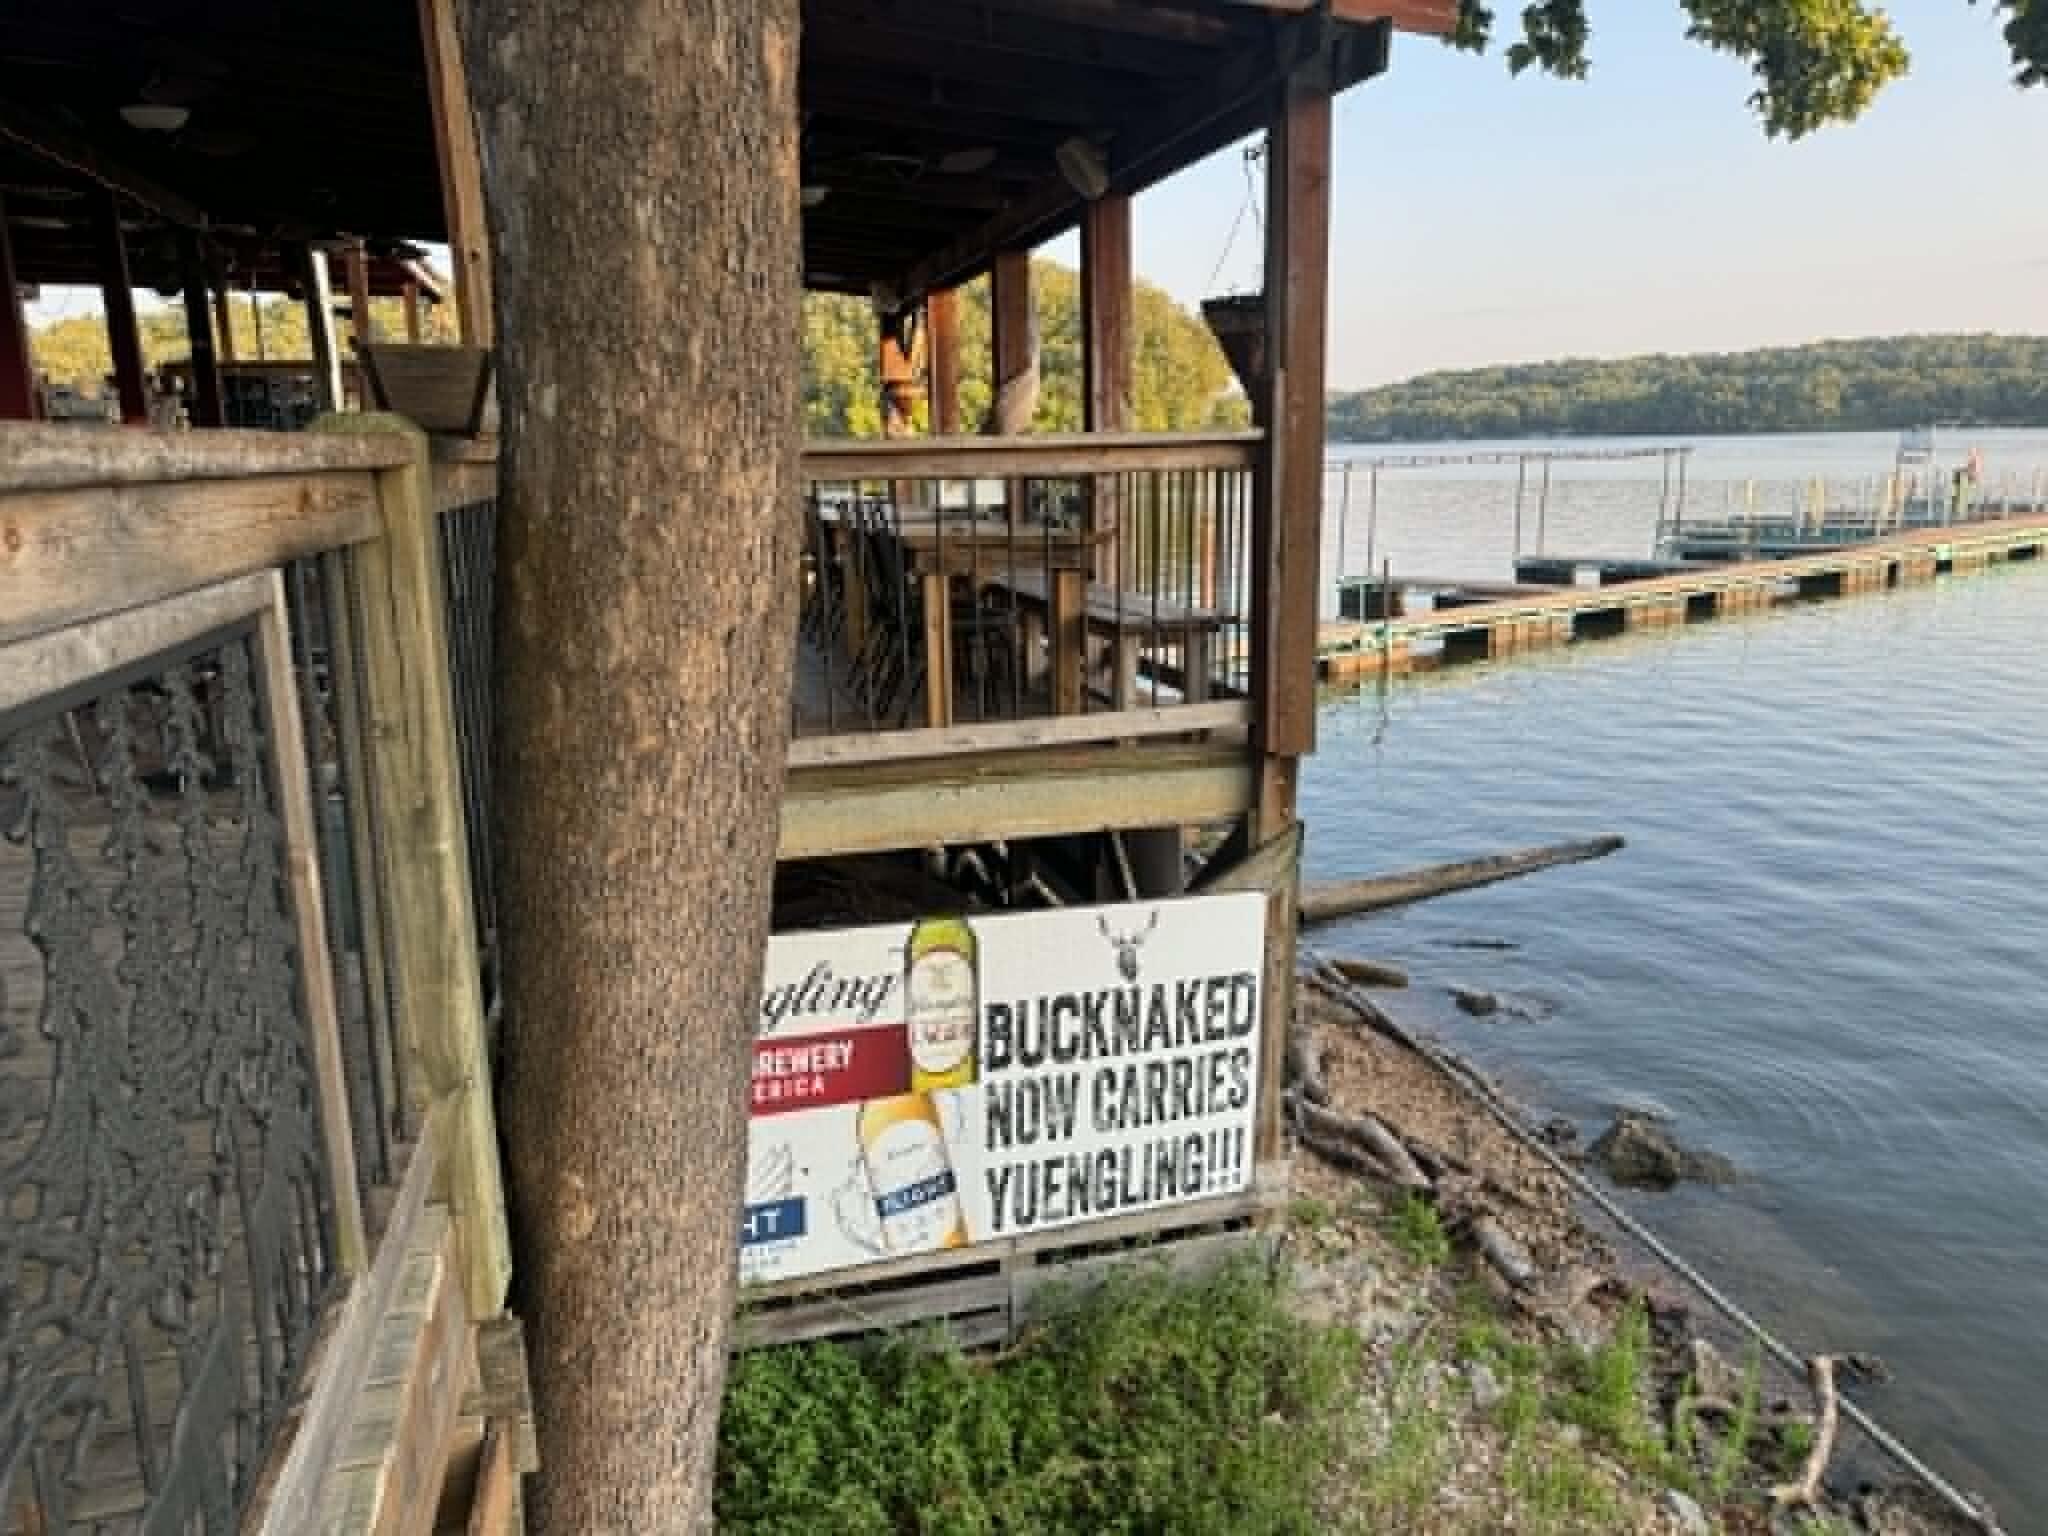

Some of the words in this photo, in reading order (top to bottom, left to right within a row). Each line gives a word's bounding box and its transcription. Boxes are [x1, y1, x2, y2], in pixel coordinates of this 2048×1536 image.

[984, 972, 1257, 1073] BUCKNAKED
[984, 1072, 1081, 1152] NOW
[1090, 1047, 1251, 1132] CARRIES
[984, 1126, 1245, 1232] YUENGLING!!!
